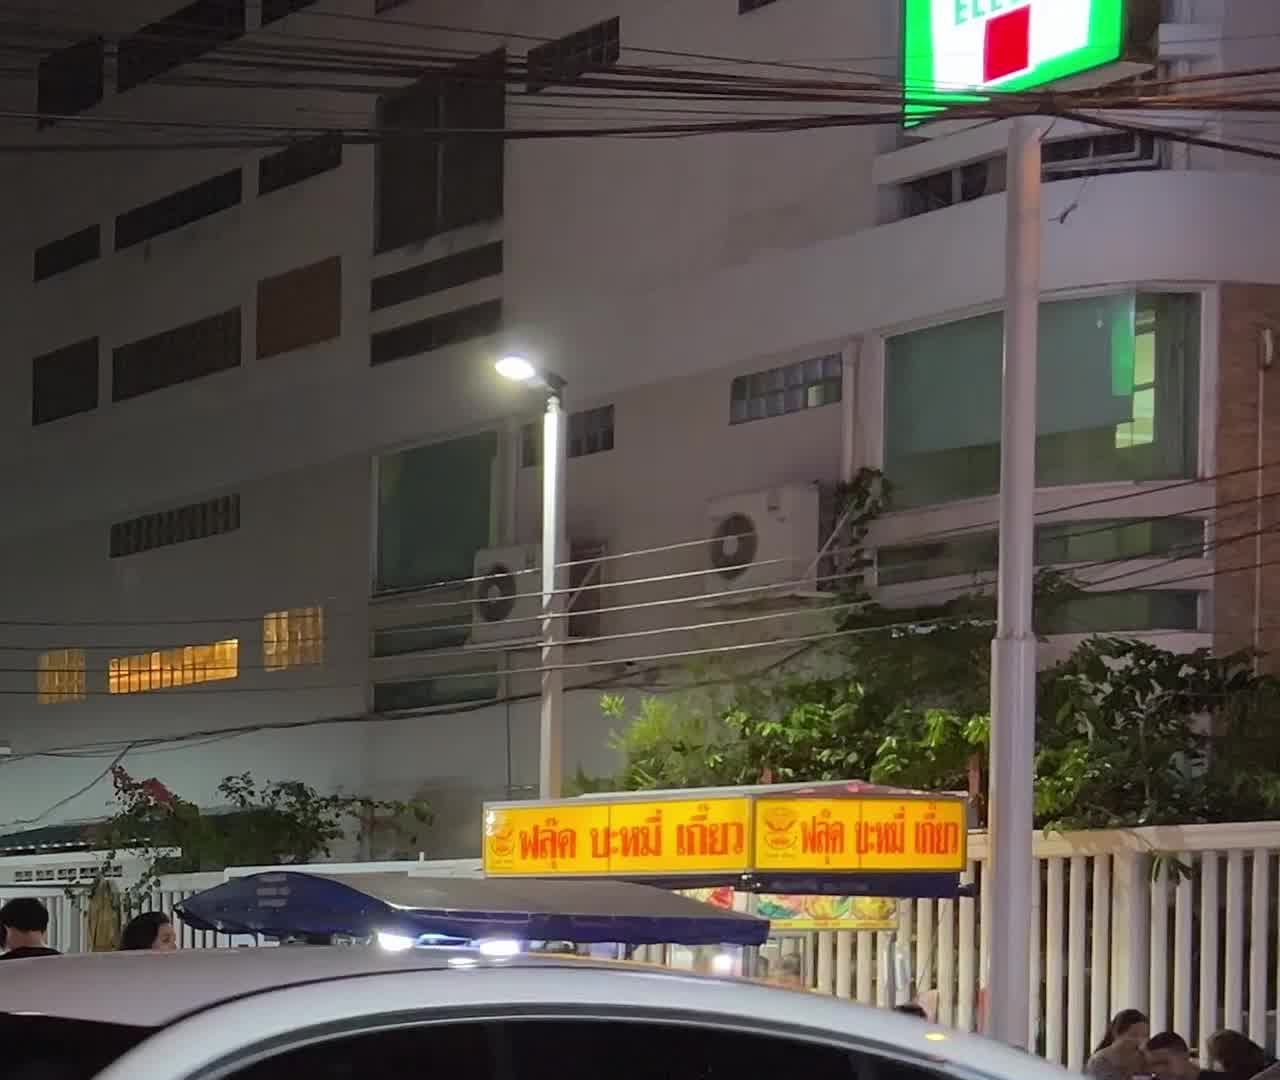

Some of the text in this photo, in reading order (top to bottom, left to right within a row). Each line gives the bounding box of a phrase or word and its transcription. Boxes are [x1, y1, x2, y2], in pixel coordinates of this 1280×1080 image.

[590, 809, 662, 859] บะหมี่
[855, 805, 905, 855] บะหมี่
